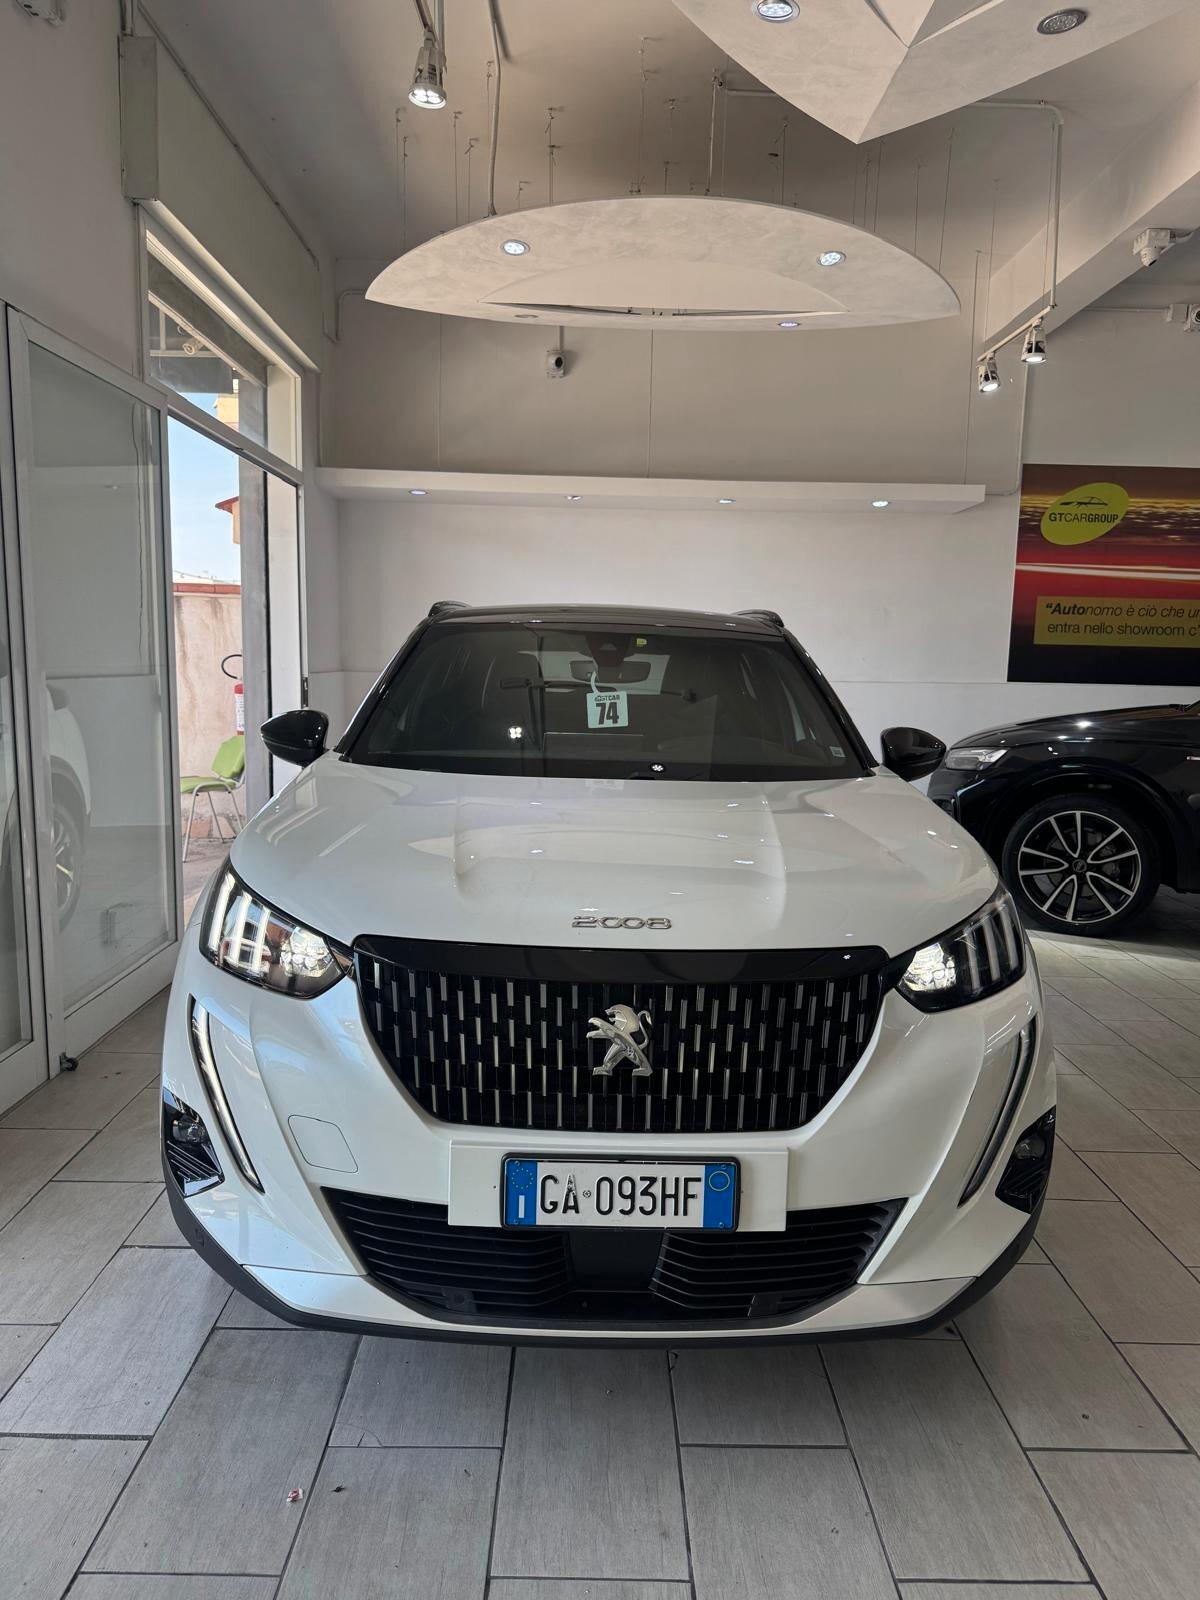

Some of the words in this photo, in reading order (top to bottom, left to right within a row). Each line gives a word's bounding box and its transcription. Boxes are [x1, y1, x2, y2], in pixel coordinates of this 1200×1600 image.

[1048, 511, 1119, 523] GTCARGROUP
[1126, 603, 1135, 617] è
[1138, 604, 1158, 617] ciò
[1161, 604, 1185, 618] che
[1047, 622, 1081, 634] entra
[1083, 622, 1114, 635] nello
[1116, 622, 1185, 637] showroom
[595, 702, 619, 724] 74
[572, 915, 672, 929] 2008
